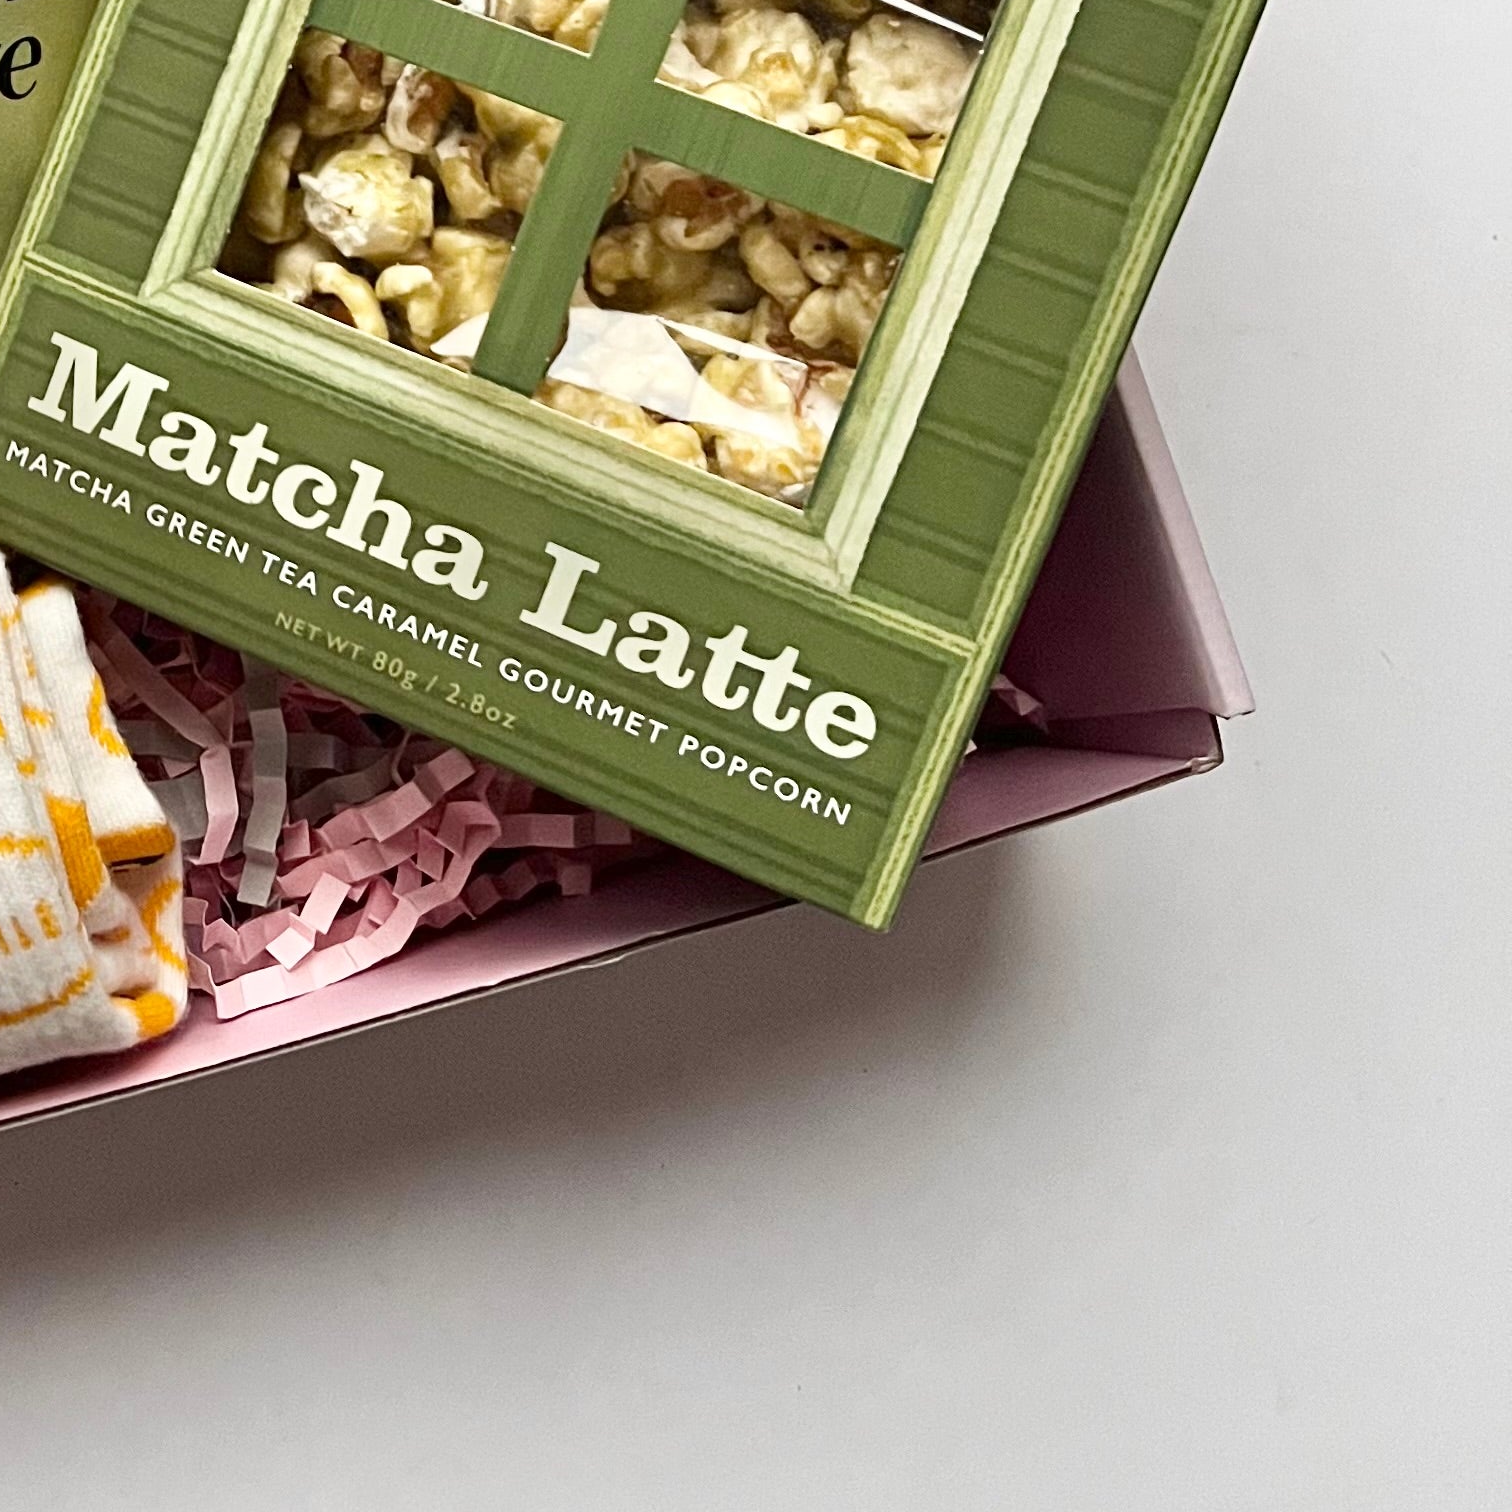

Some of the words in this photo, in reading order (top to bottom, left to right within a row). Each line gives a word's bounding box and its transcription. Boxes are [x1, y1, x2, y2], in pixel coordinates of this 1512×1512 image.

[5, 440, 133, 515] MATCHA
[145, 501, 249, 565] GREEN
[261, 550, 318, 597] TEA
[331, 585, 483, 669] CARAMEL
[498, 658, 669, 745] GOURMET
[677, 732, 852, 827] POPCORN
[27, 331, 488, 601] Matcha
[519, 541, 877, 760] Latte
[275, 611, 322, 641] NET
[326, 631, 365, 660] WT
[372, 650, 418, 691] 80g
[425, 674, 439, 692] /
[445, 683, 517, 730] 2.8oz
